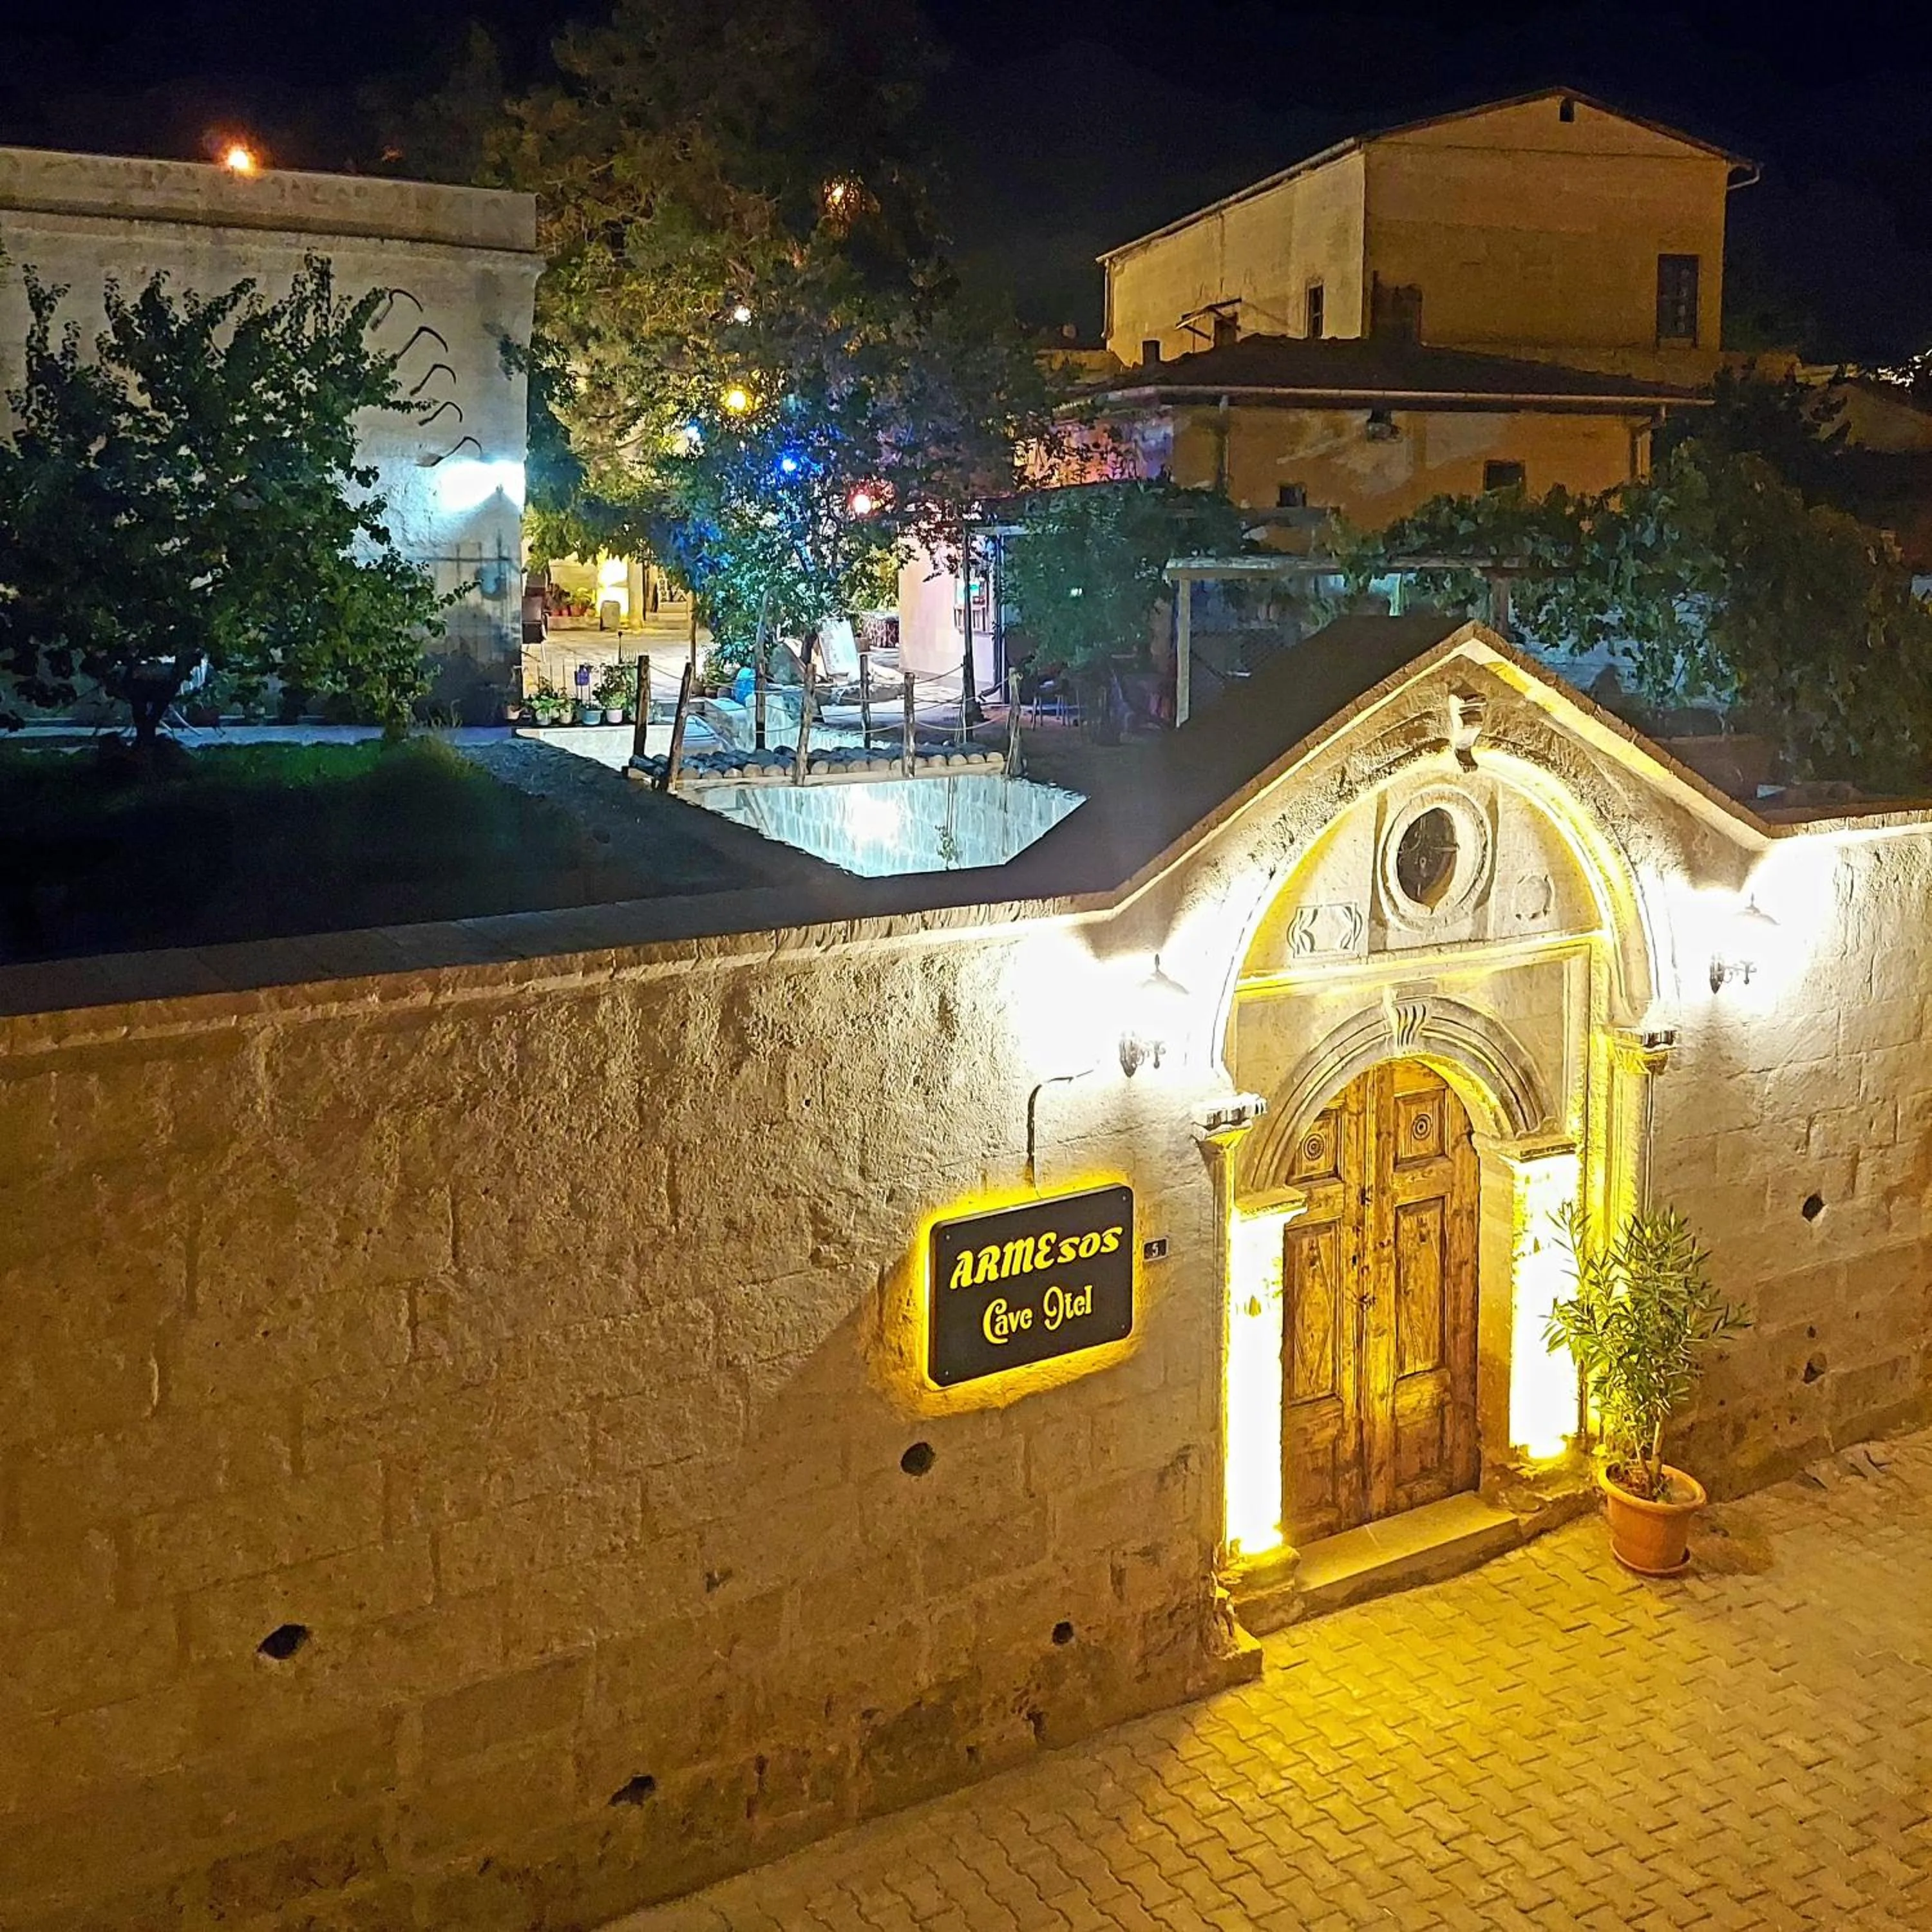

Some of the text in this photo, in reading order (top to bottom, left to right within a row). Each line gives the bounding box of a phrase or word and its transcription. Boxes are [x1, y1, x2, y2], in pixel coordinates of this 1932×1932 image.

[1151, 1242, 1159, 1257] 5
[983, 1286, 1093, 1344] Cave Otel
